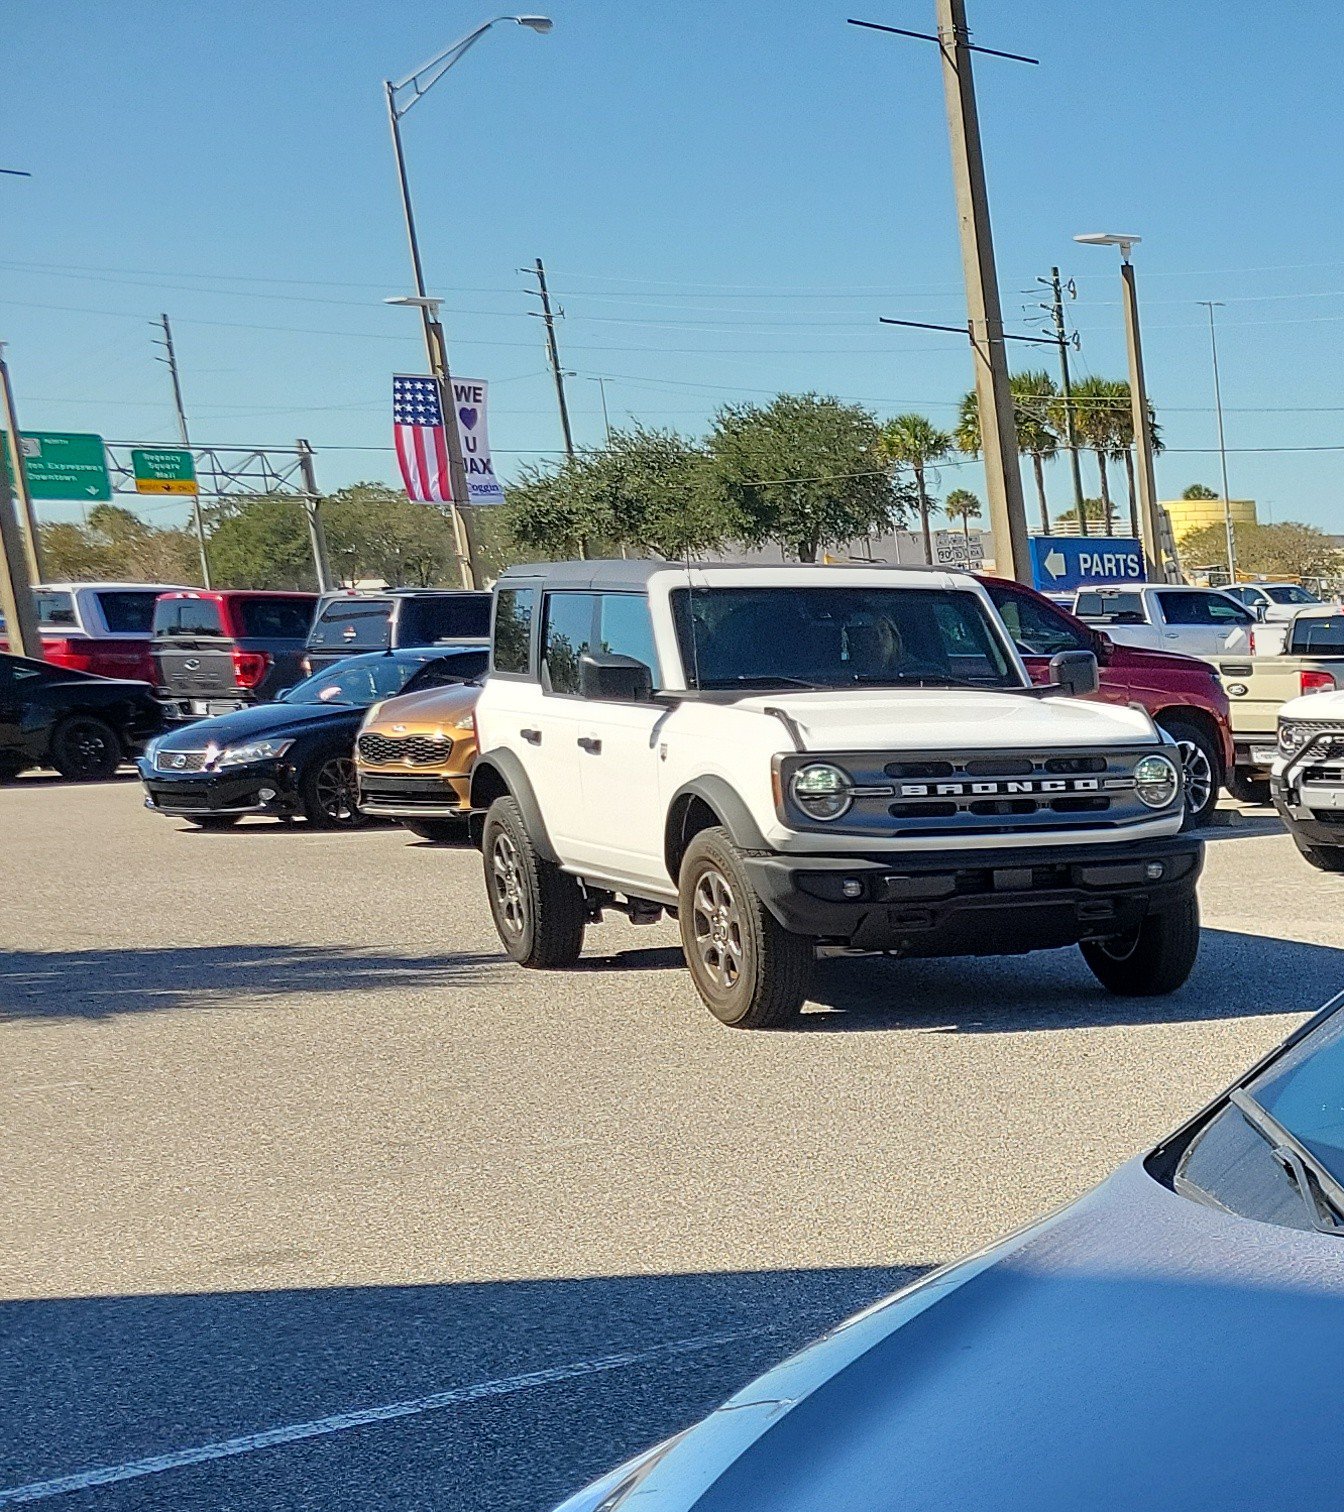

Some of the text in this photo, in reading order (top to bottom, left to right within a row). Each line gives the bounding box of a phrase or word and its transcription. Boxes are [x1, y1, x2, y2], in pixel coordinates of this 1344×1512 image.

[454, 385, 483, 403] WE
[465, 436, 477, 454] U
[142, 453, 181, 462] Regency
[147, 462, 181, 471] Square
[48, 462, 103, 473] Expressway
[1079, 553, 1140, 577] PARTS
[901, 778, 1099, 796] BRONCO
